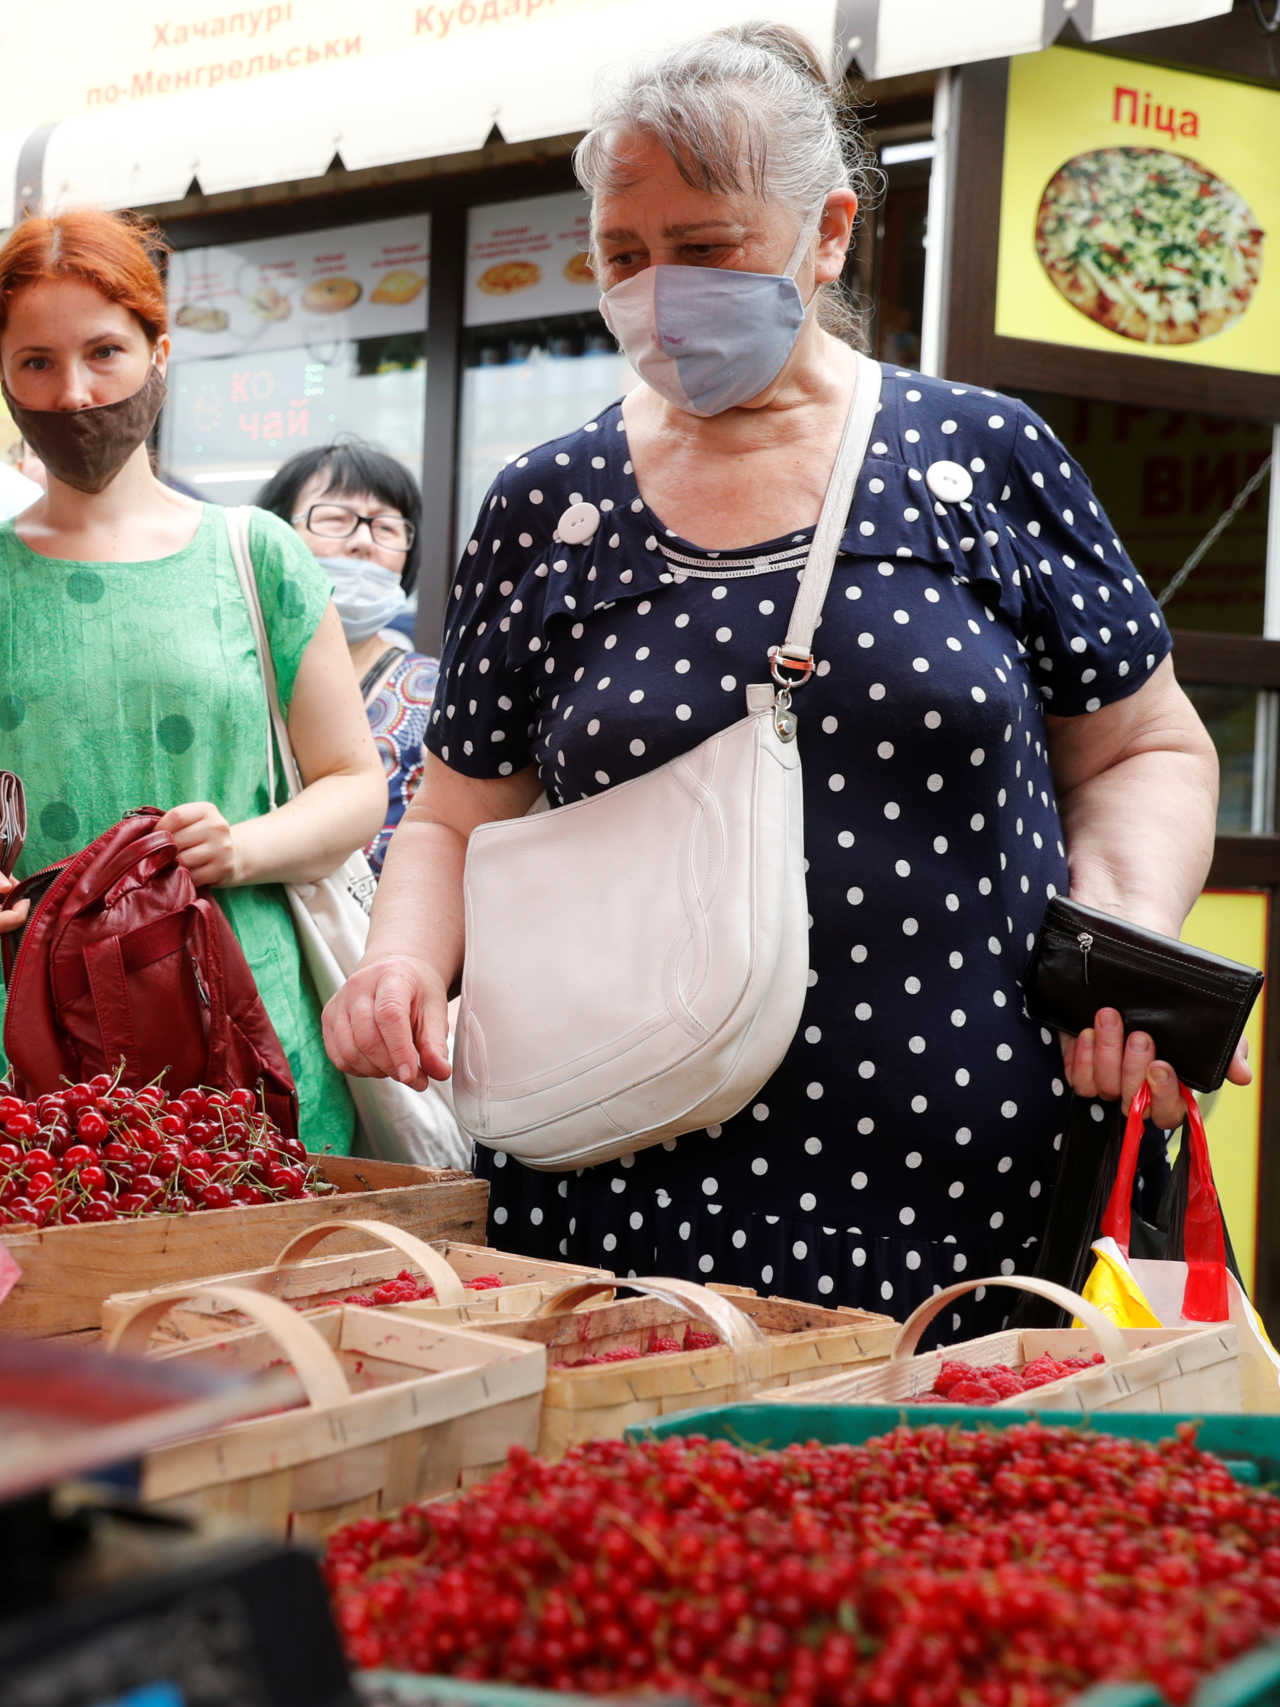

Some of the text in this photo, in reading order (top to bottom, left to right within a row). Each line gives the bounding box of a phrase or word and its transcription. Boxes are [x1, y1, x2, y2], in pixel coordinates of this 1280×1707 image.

[414, 0, 556, 39] Кубдар
[85, 34, 364, 107] по-Менгрельськи
[1111, 86, 1200, 141] Піца
